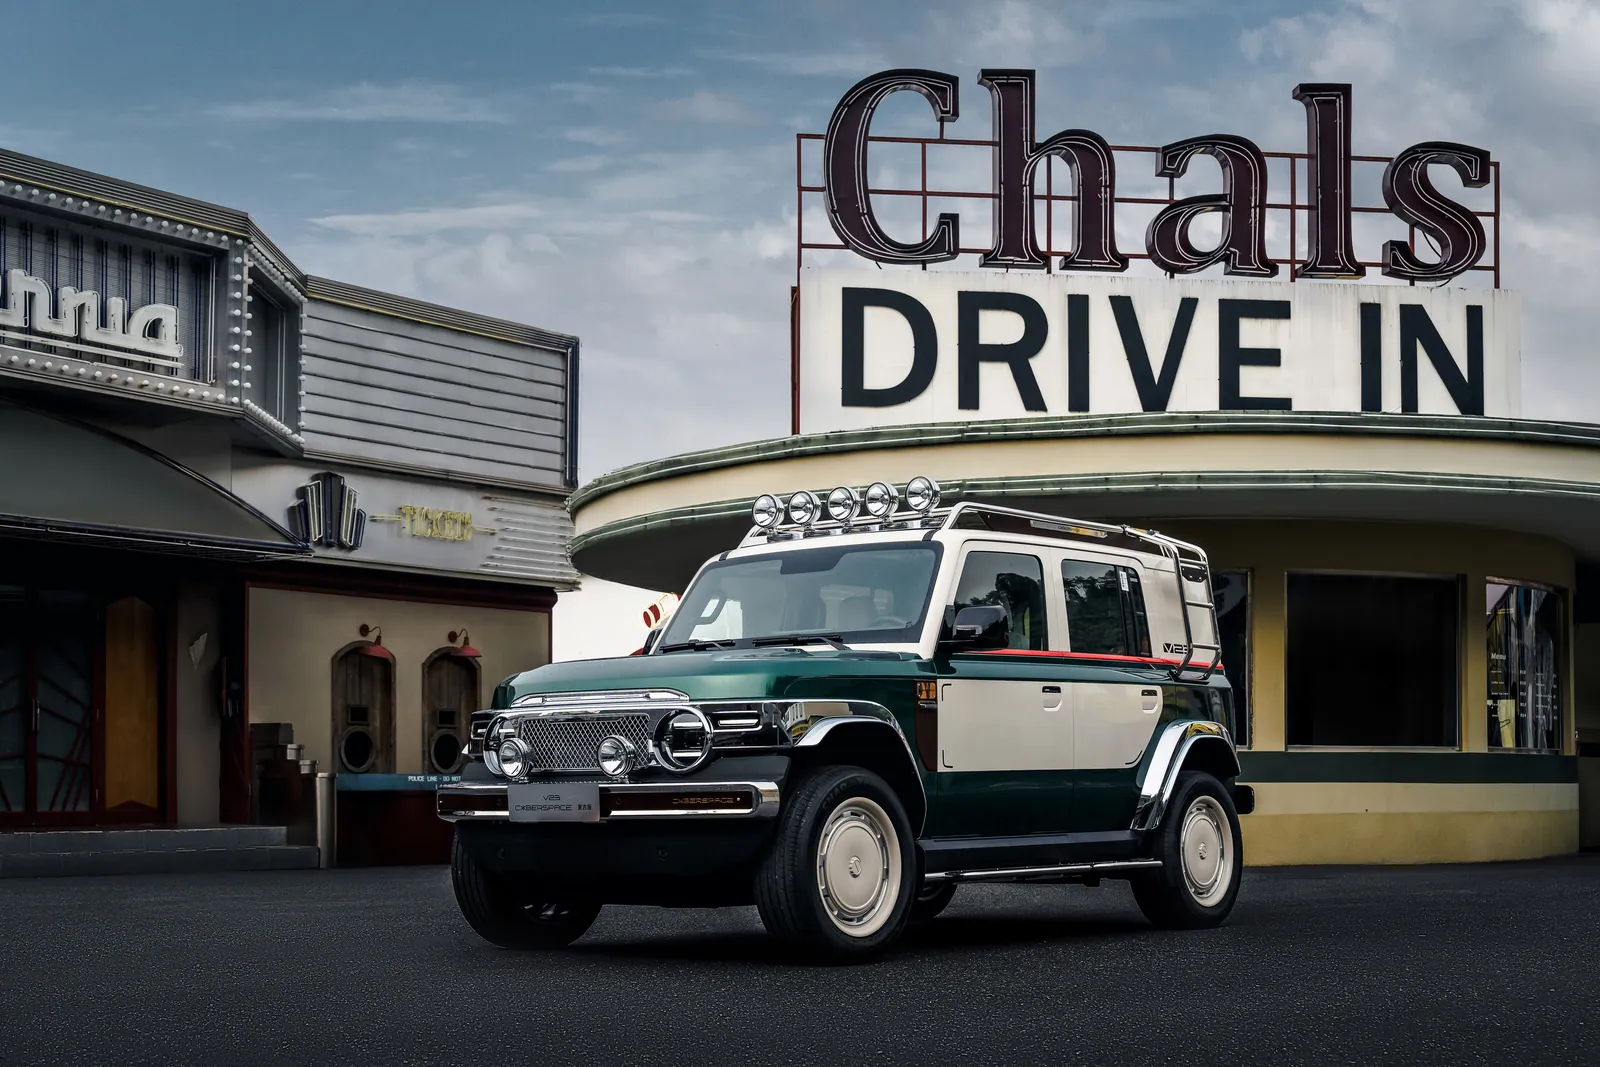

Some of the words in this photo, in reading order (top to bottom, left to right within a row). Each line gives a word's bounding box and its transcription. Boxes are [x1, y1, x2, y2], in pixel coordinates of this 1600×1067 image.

[824, 68, 1491, 279] Chals
[841, 287, 1292, 412] DRIVE
[1361, 302, 1485, 415] IN
[400, 504, 473, 540] TICKETS
[1491, 652, 1506, 660] Menu
